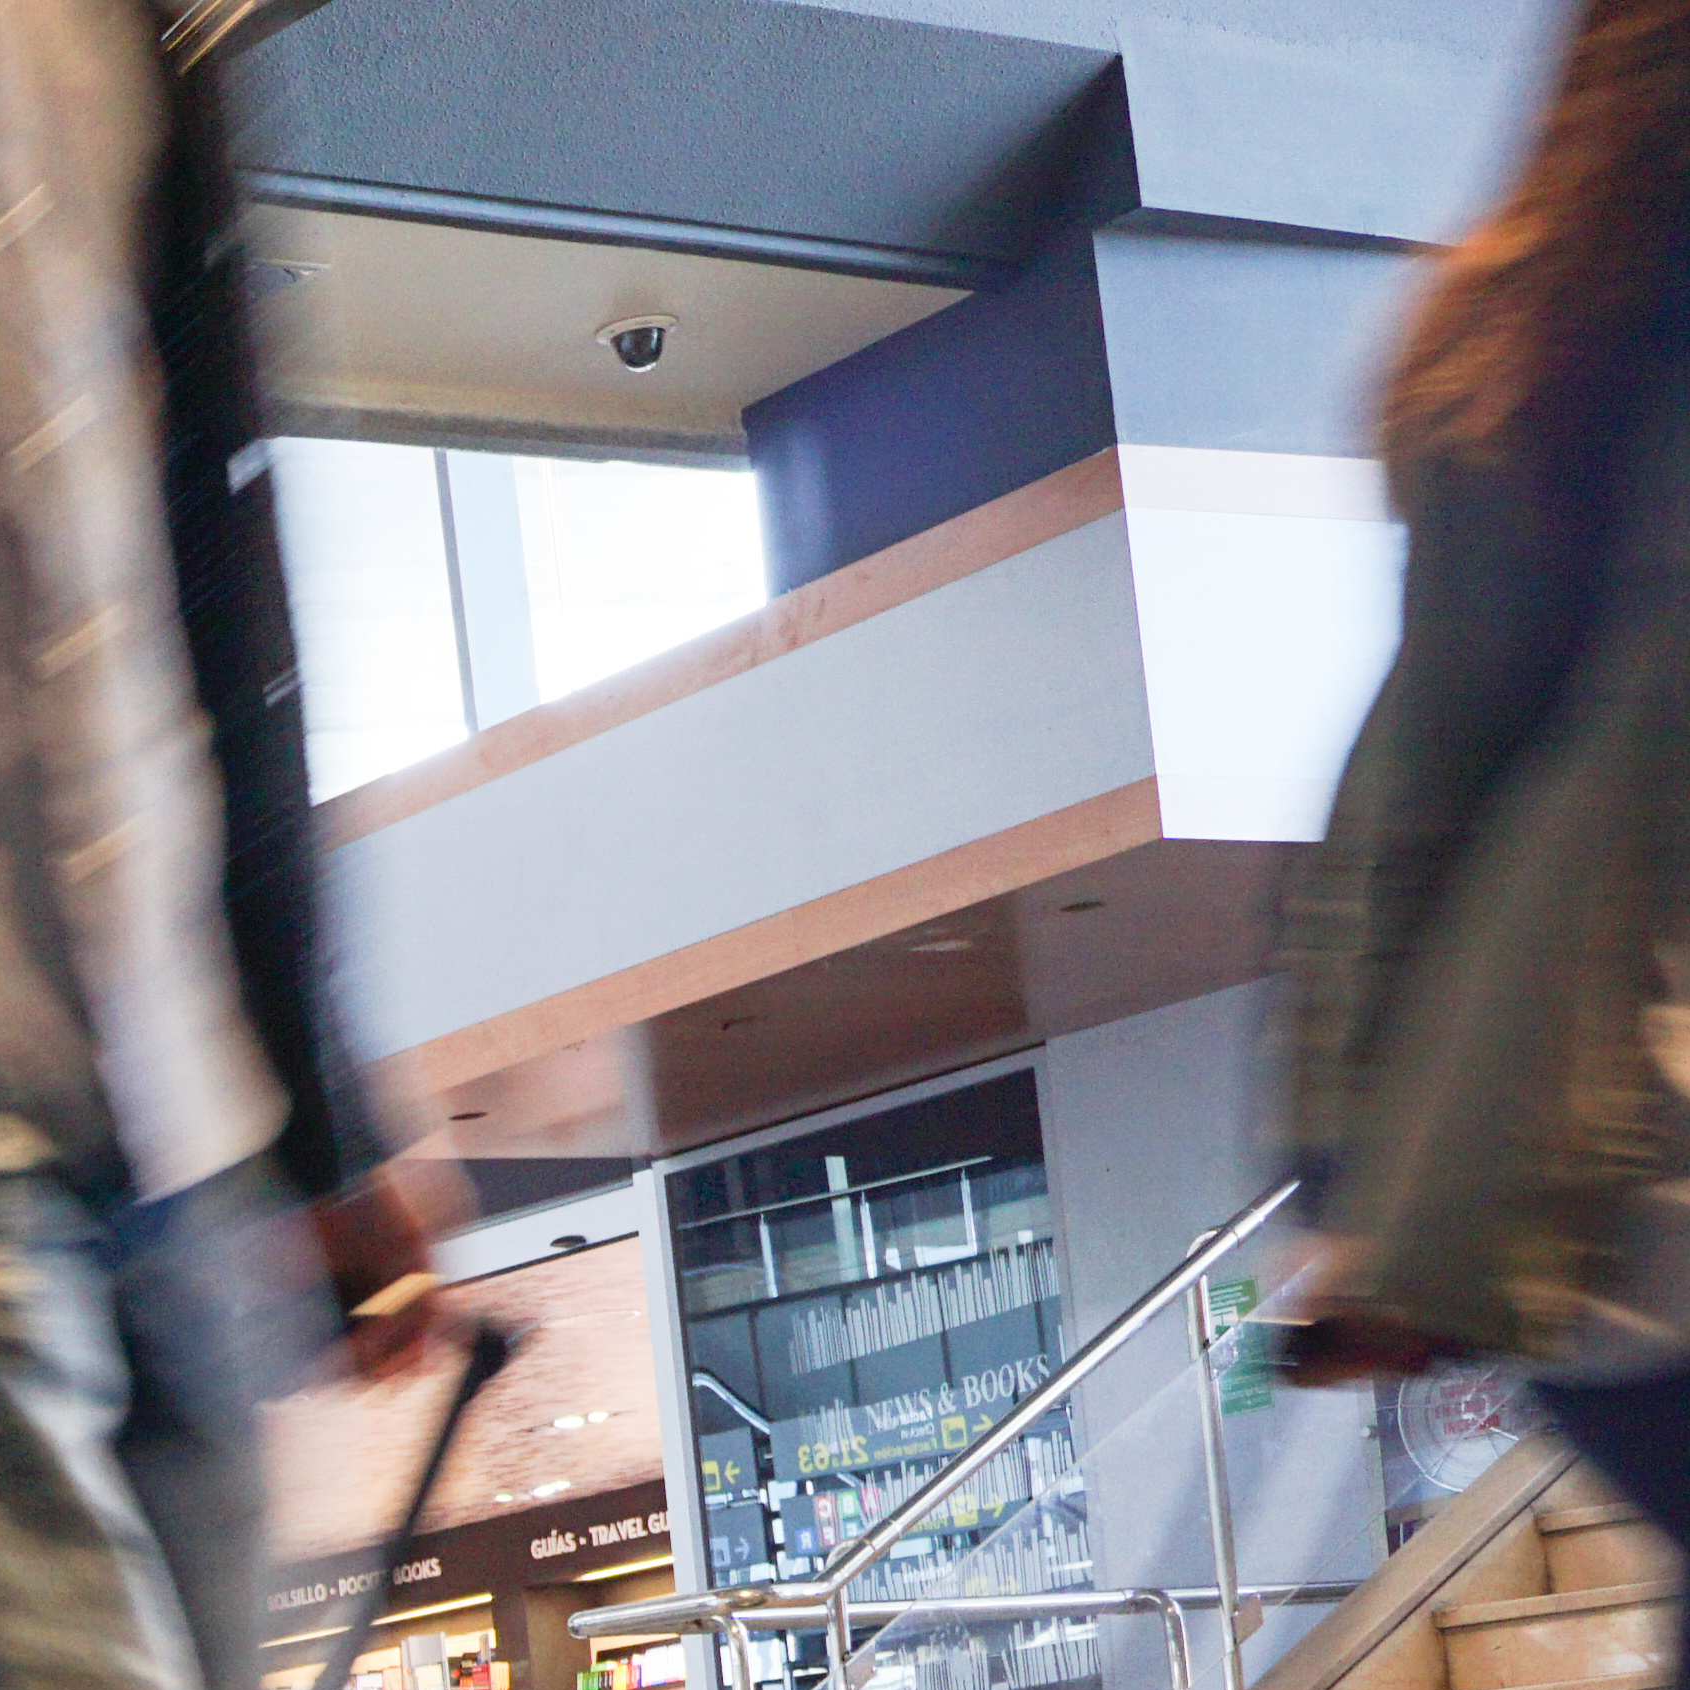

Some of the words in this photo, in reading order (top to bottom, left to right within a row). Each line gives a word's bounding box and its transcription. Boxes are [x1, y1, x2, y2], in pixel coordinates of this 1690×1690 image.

[937, 1381, 956, 1416] &
[961, 1354, 1051, 1409] BOOKS
[588, 1517, 648, 1547] TRAVEL
[647, 1510, 670, 1534] GU
